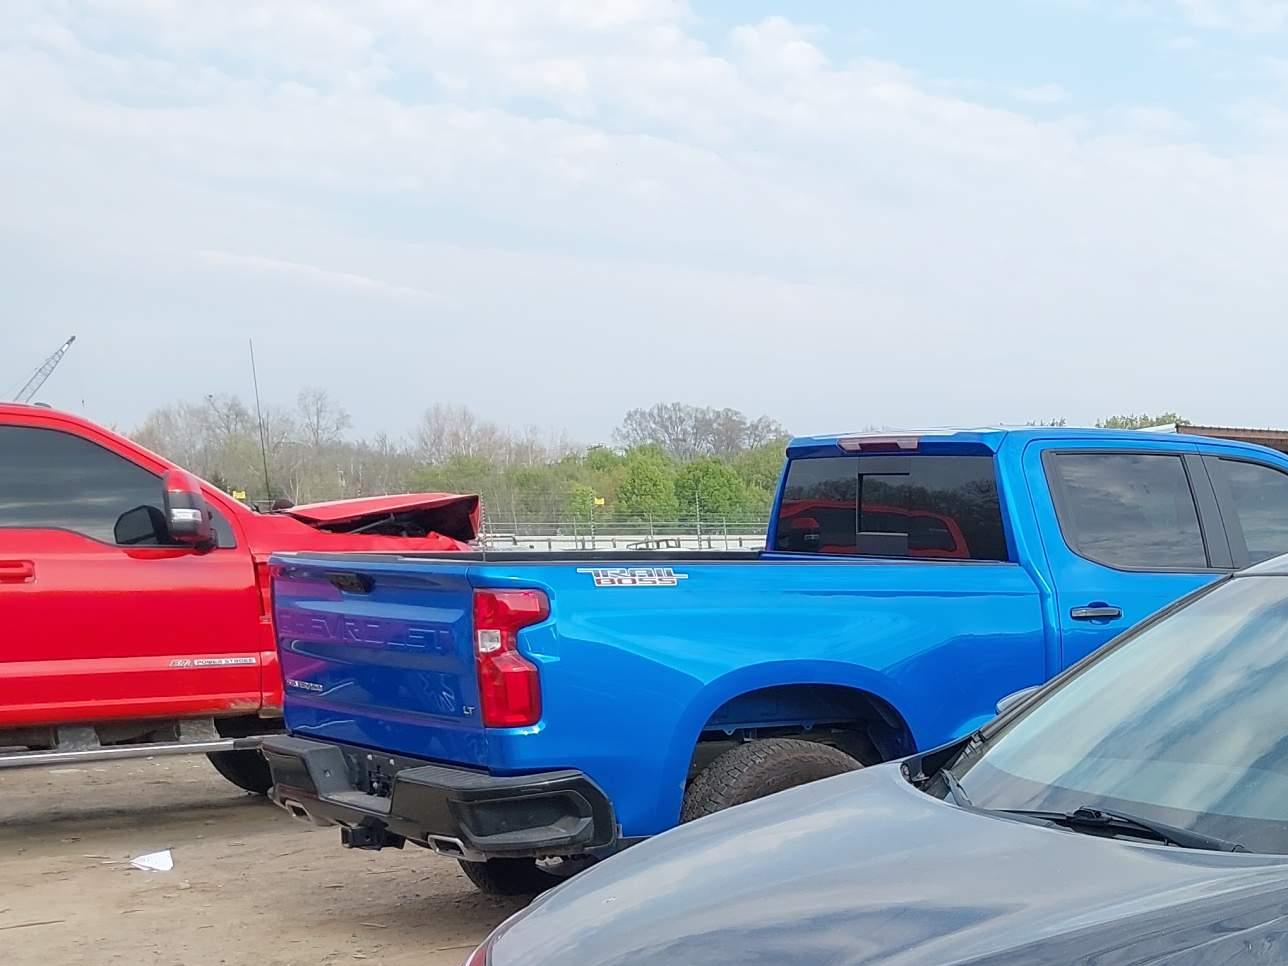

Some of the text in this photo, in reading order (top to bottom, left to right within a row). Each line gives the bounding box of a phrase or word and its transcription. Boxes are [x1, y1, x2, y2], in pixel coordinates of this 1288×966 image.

[577, 567, 688, 578] TRAIL
[595, 577, 676, 586] BOSS
[463, 705, 475, 715] LT
